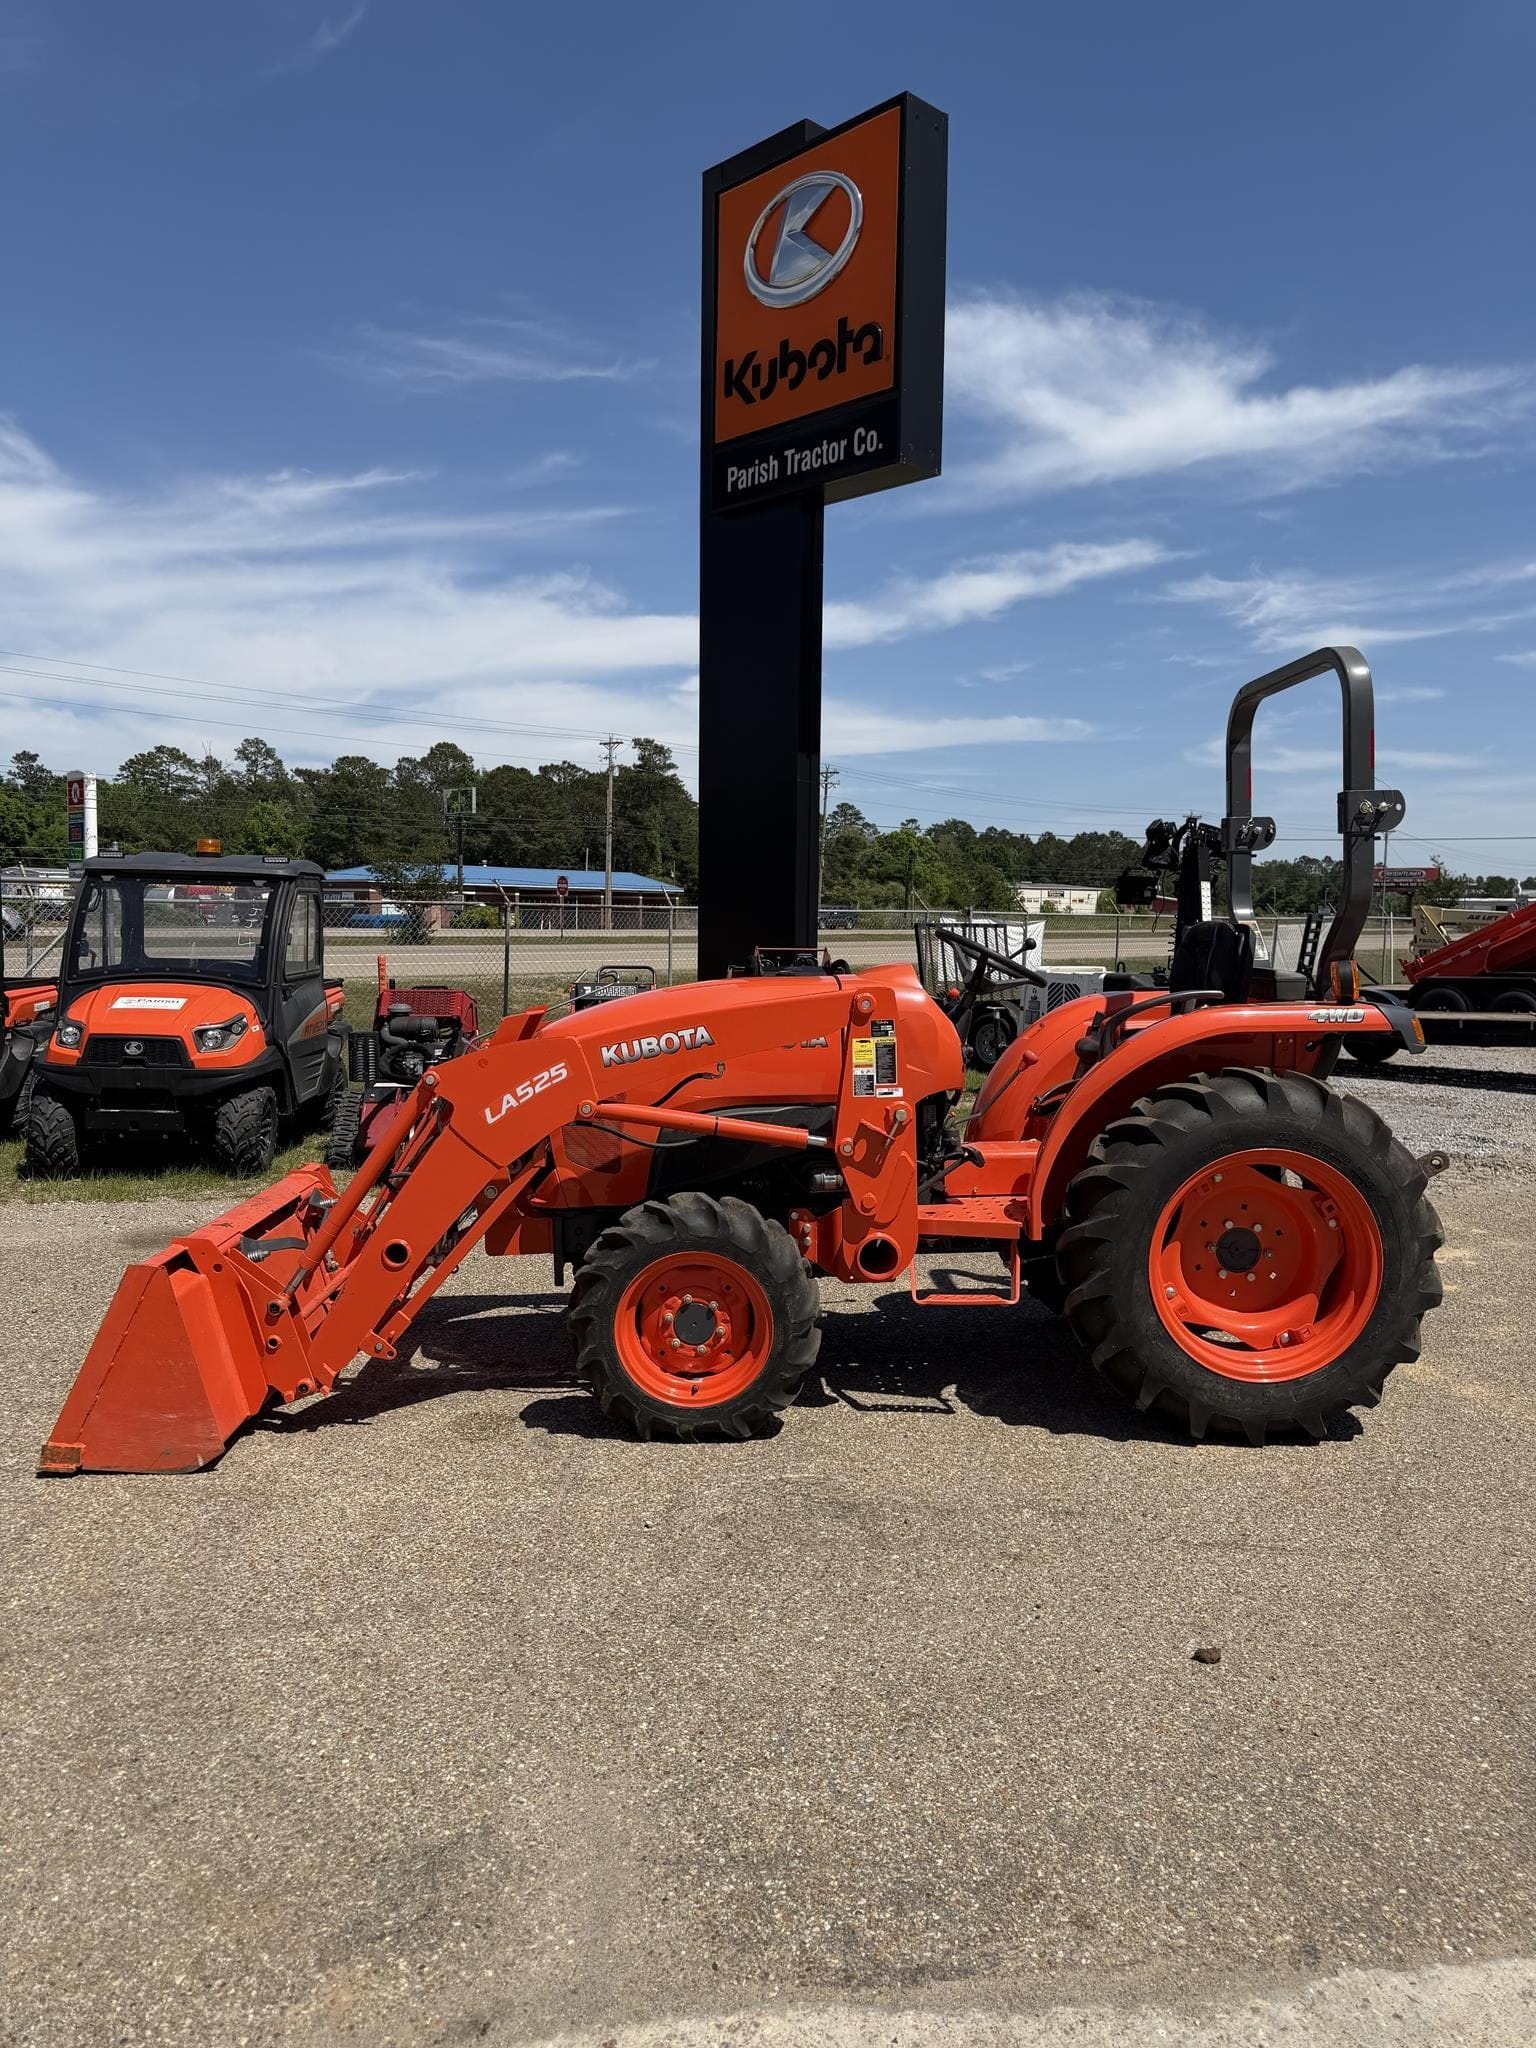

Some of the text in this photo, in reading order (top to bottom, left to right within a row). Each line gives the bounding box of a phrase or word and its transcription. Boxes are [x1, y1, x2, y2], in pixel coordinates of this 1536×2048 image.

[723, 316, 883, 405] Kubota
[727, 427, 883, 493] Parish Tractor Co.
[600, 1025, 715, 1068] KUBOTA
[1308, 1008, 1365, 1023] 4WD
[484, 1062, 568, 1124] LA525
